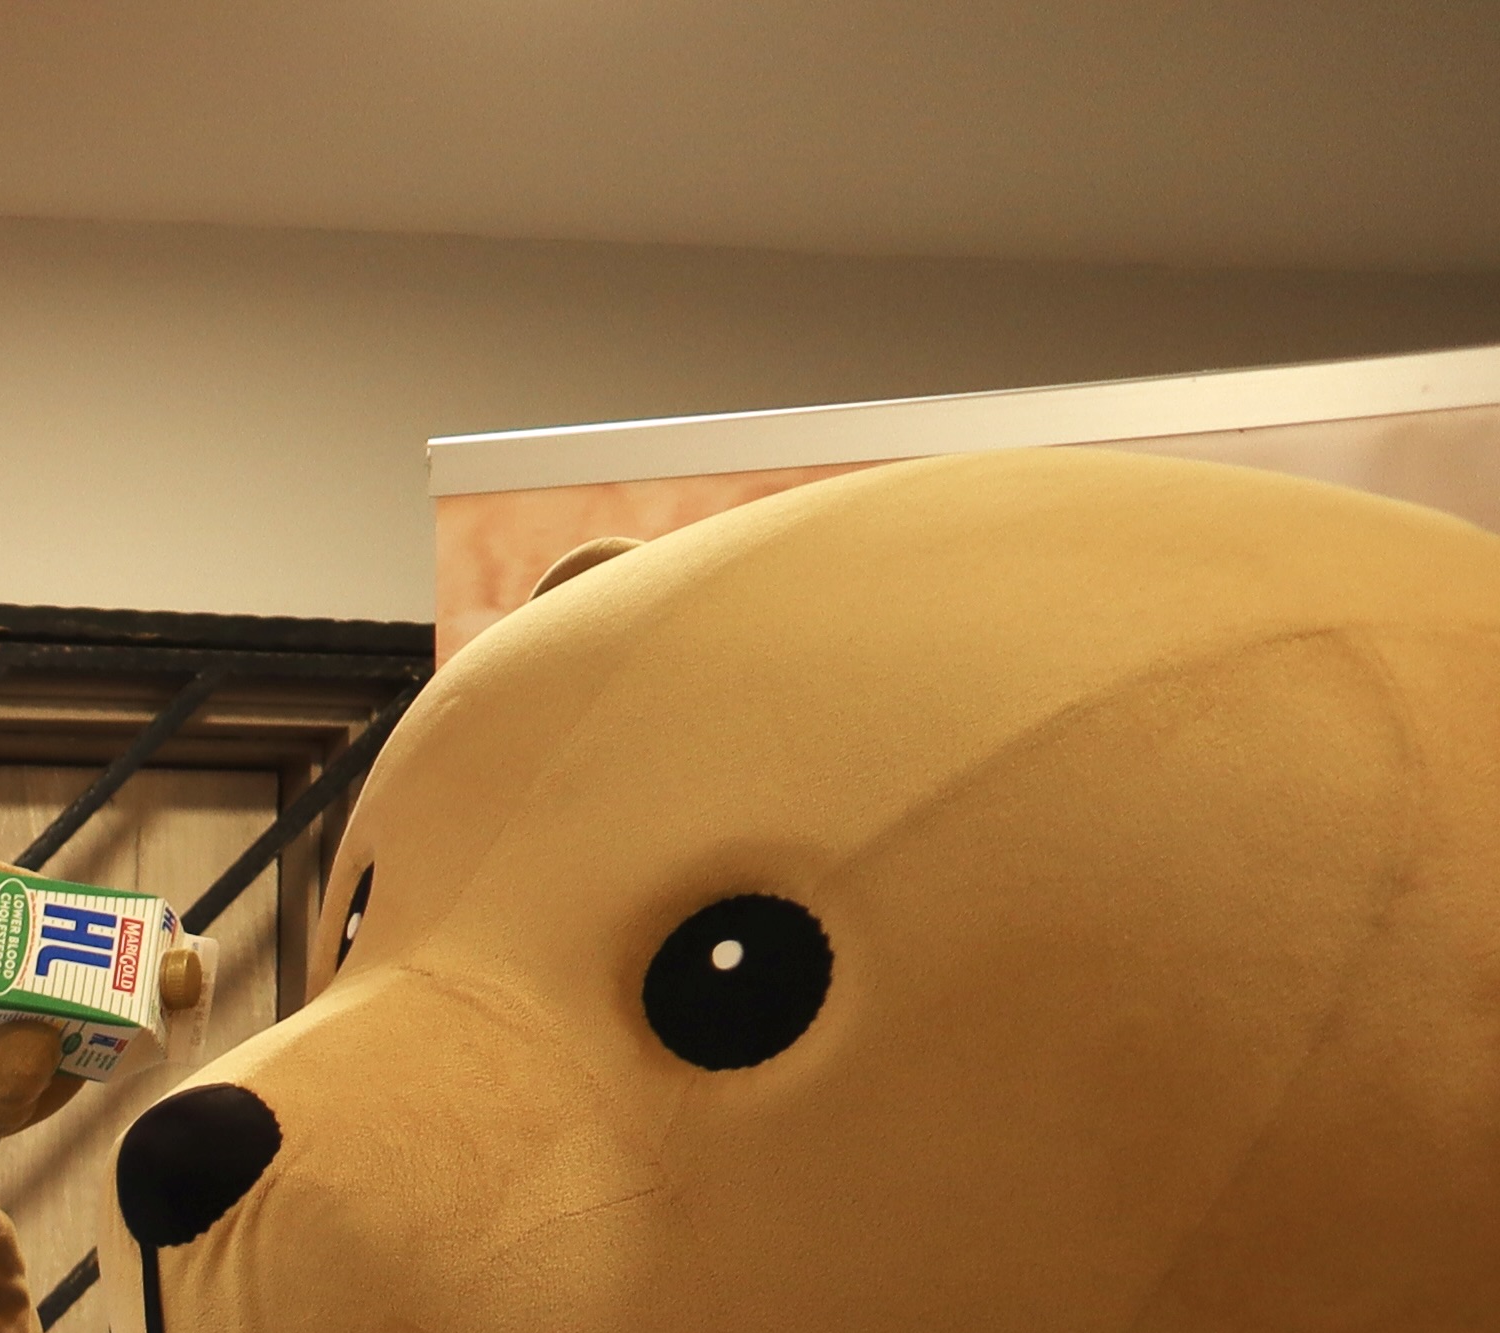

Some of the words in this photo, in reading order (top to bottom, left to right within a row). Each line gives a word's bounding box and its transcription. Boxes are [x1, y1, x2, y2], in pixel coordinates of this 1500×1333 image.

[9, 893, 25, 935] LOWER
[35, 903, 118, 977] HL
[2, 935, 20, 980] BLOOD
[119, 921, 141, 989] MARIGOLD
